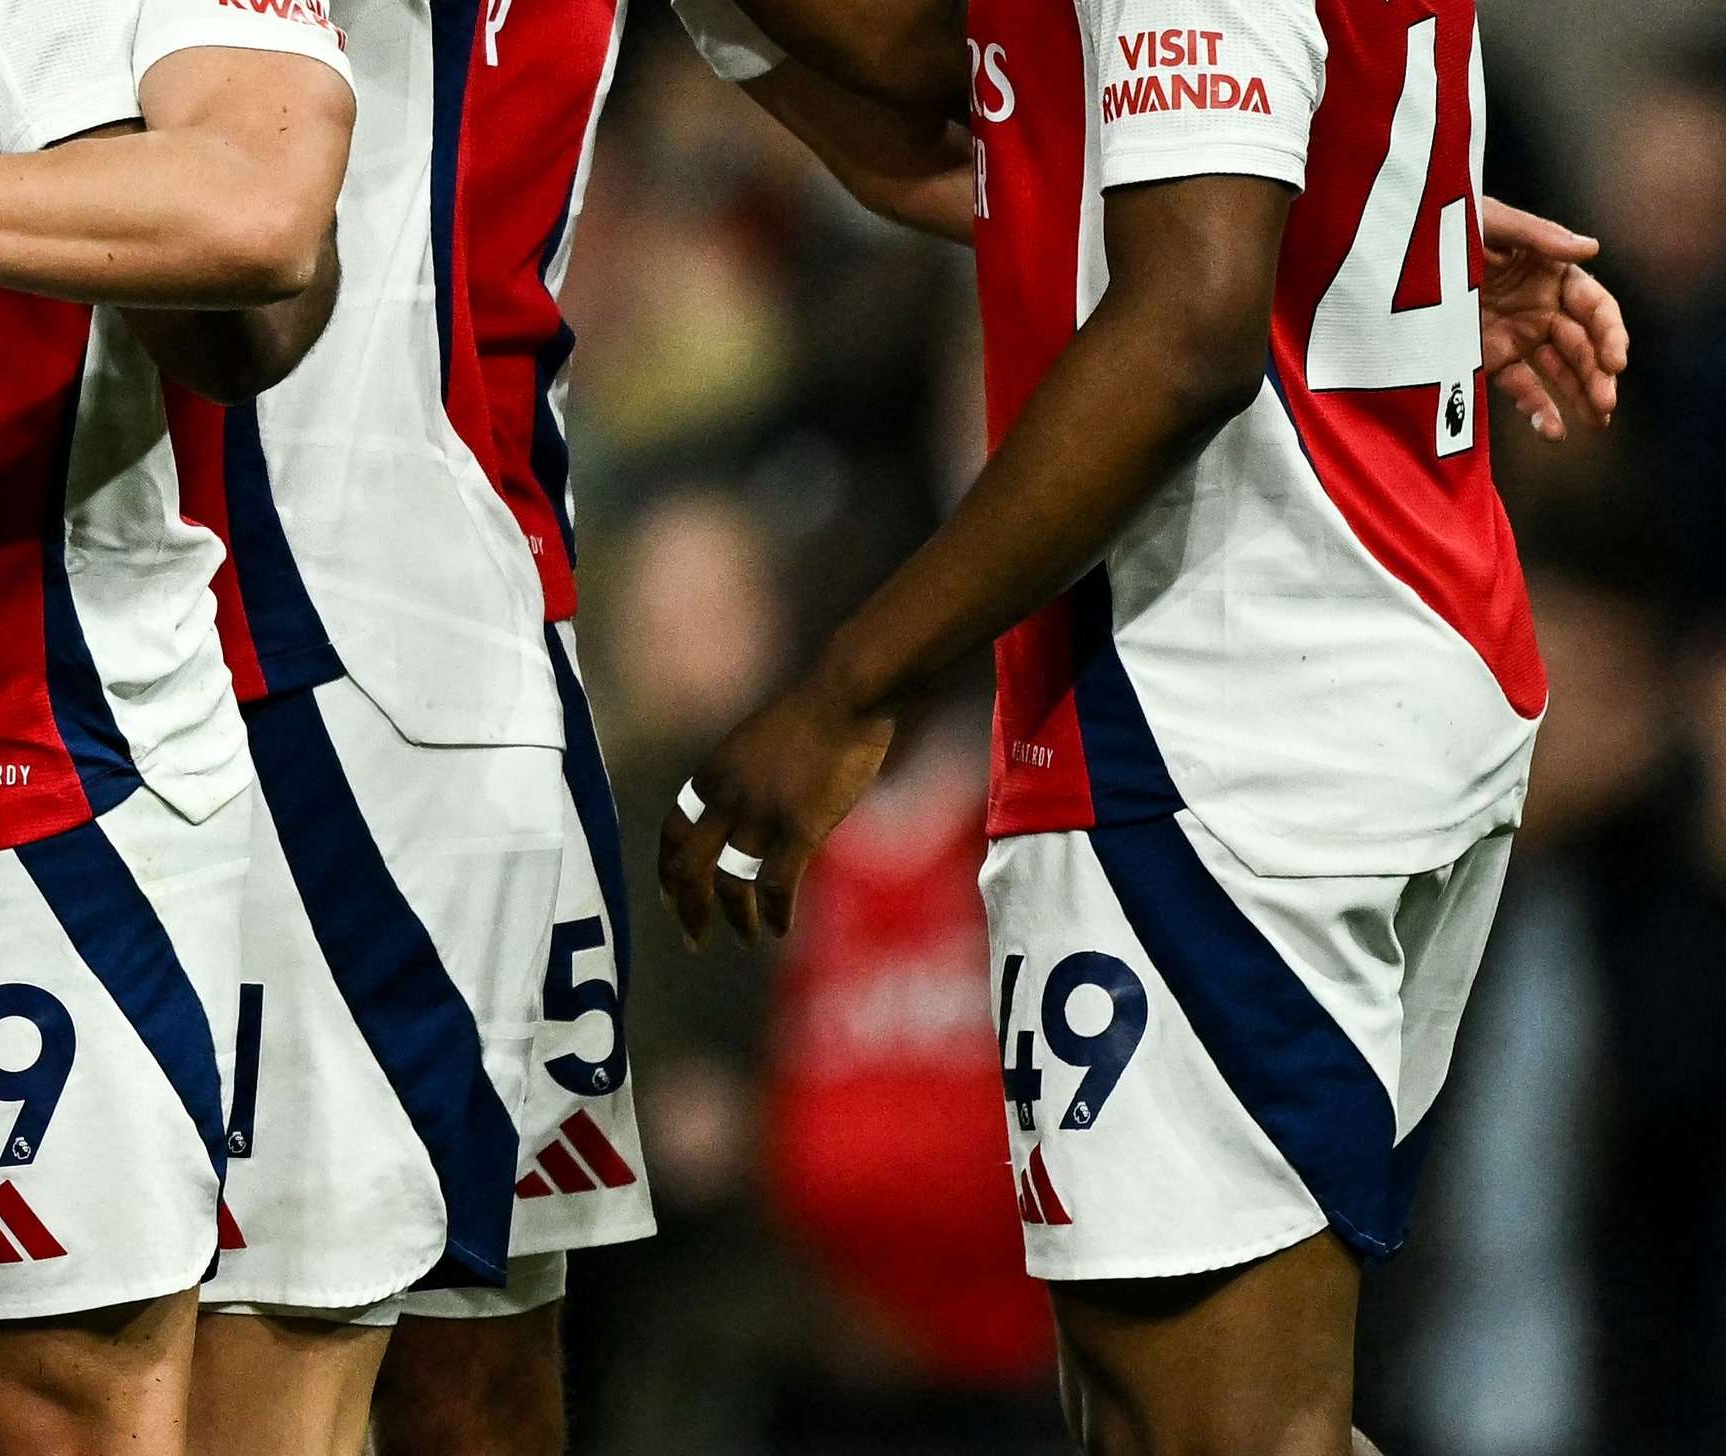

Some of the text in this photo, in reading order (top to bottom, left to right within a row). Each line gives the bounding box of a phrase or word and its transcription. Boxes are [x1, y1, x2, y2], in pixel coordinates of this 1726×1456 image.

[1118, 28, 1224, 71] VISIT
[1102, 73, 1272, 124] RWANDA
[998, 950, 1149, 1132] 49
